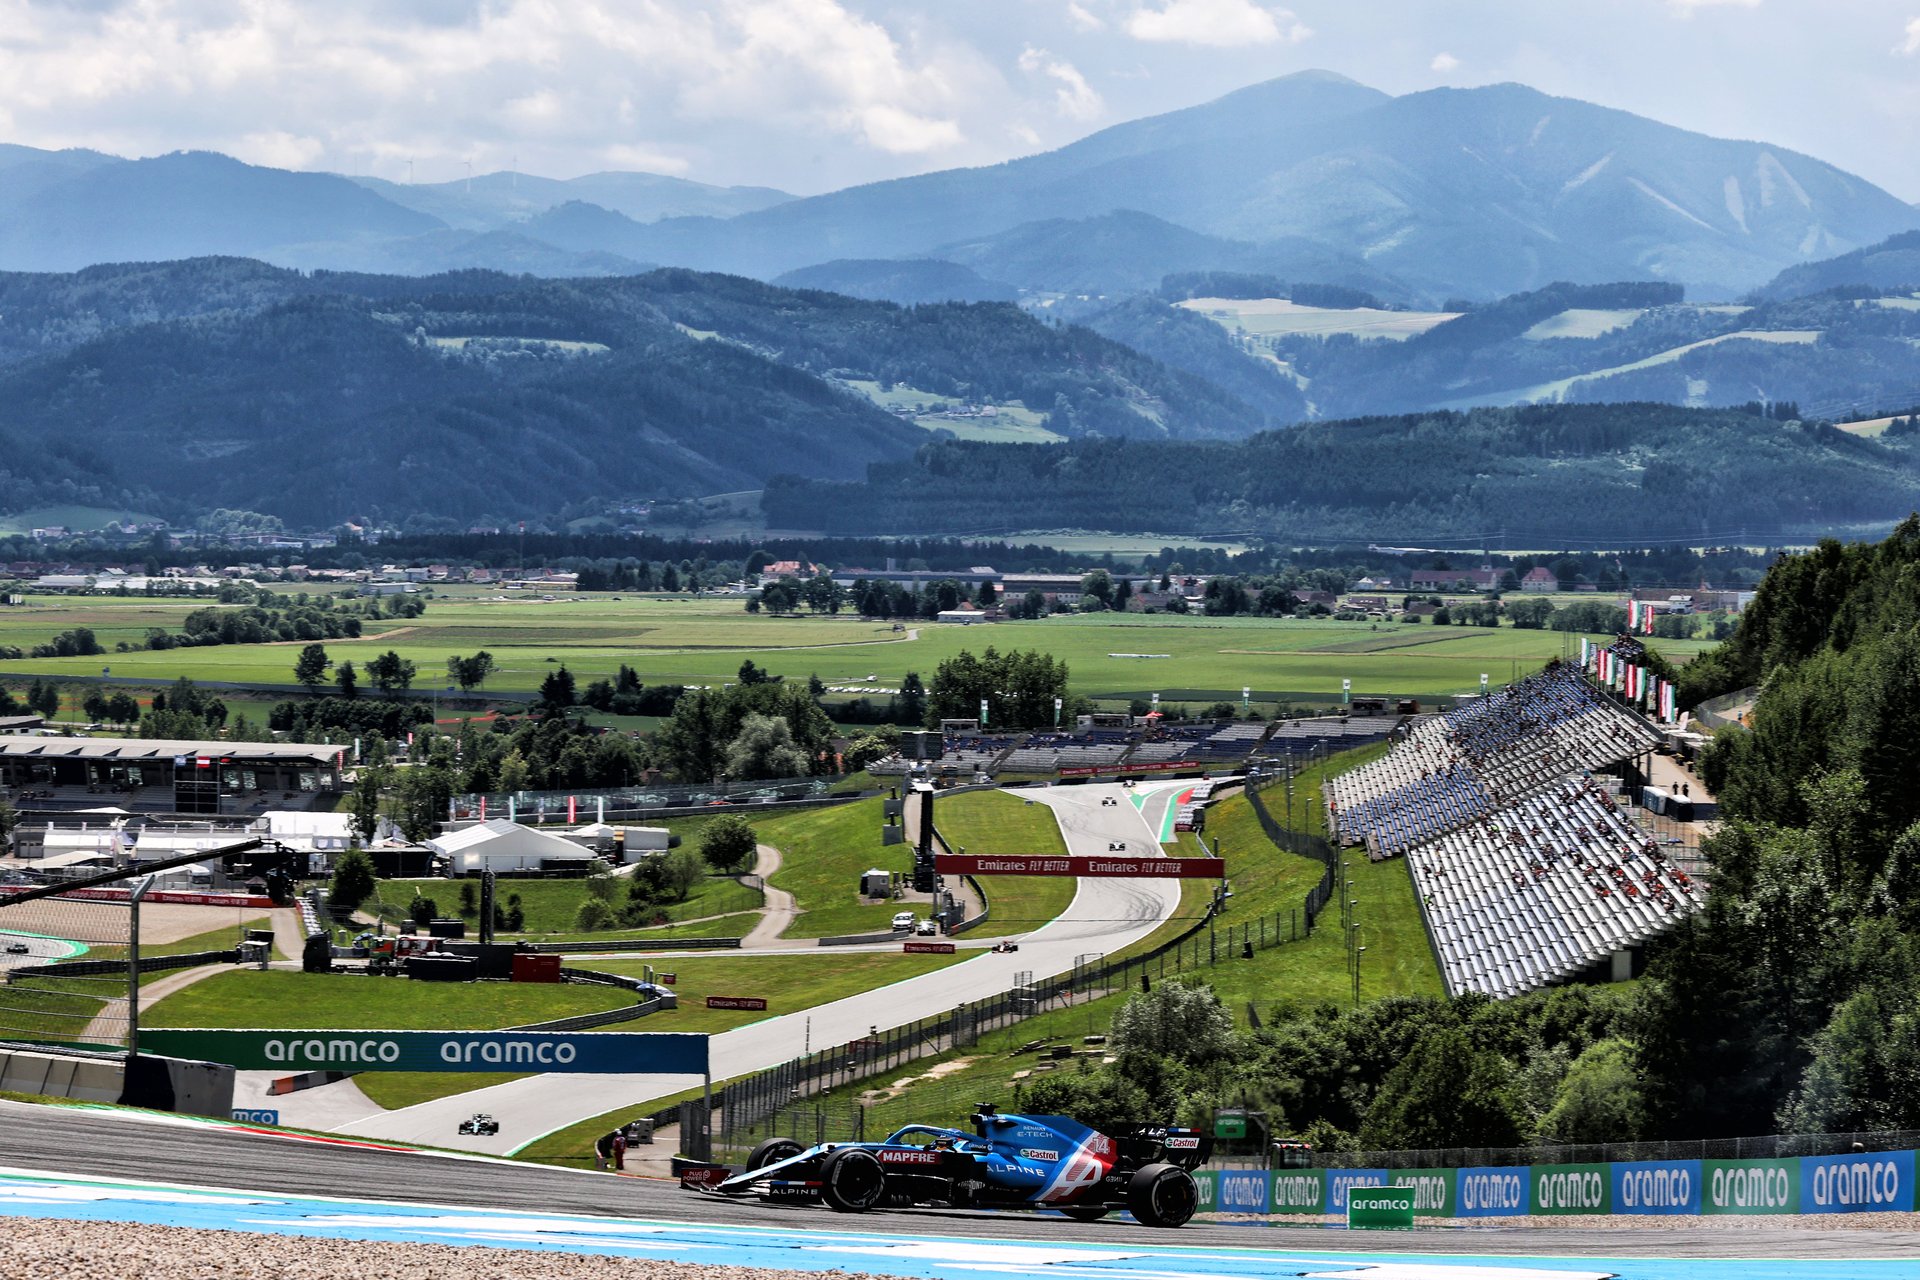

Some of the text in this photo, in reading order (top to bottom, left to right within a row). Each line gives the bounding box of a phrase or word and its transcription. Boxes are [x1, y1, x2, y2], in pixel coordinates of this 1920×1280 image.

[977, 859, 1070, 872] Emirates FLY BETTER
[1088, 860, 1182, 874] Emirates FLY BETTER
[264, 1039, 400, 1063] aramco
[440, 1040, 576, 1065] aramco
[1030, 1150, 1057, 1160] Castrol
[1092, 1137, 1111, 1154] 14
[1173, 1139, 1197, 1148] Castrol
[882, 1152, 936, 1163] MAPFRE
[986, 1164, 1046, 1177] ALPINE
[1223, 1176, 1265, 1207] aramco
[1275, 1176, 1319, 1207] aramco
[1463, 1175, 1521, 1210] aramco
[1538, 1171, 1602, 1209] aramco
[1622, 1169, 1690, 1207] aramco
[1711, 1167, 1789, 1208] aramco
[1812, 1161, 1899, 1206] aramco
[1351, 1199, 1410, 1211] aramco
